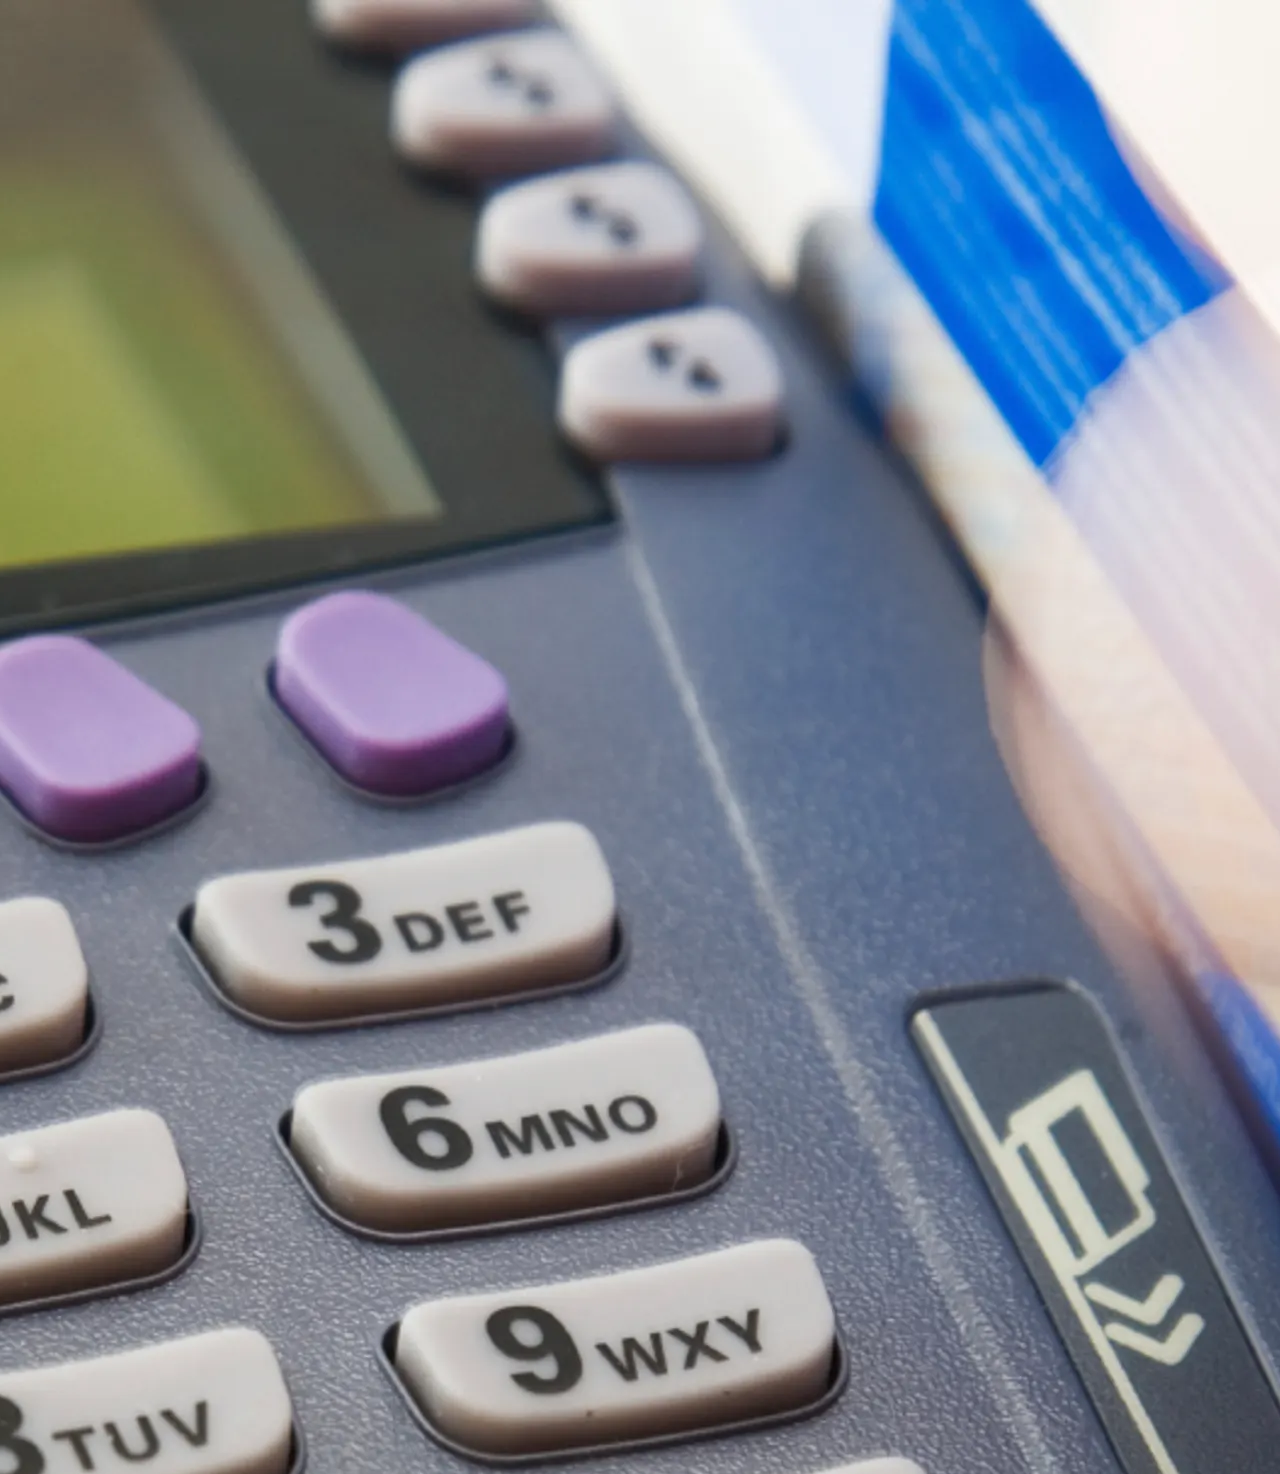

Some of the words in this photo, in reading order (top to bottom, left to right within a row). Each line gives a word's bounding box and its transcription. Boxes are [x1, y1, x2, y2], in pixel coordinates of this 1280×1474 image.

[287, 880, 382, 964] 3
[393, 891, 530, 953] DEF
[379, 1086, 473, 1171] 6
[485, 1095, 658, 1159] MNO
[485, 1305, 583, 1394] 9
[595, 1308, 763, 1382] WXY
[51, 1401, 207, 1471] TUV
